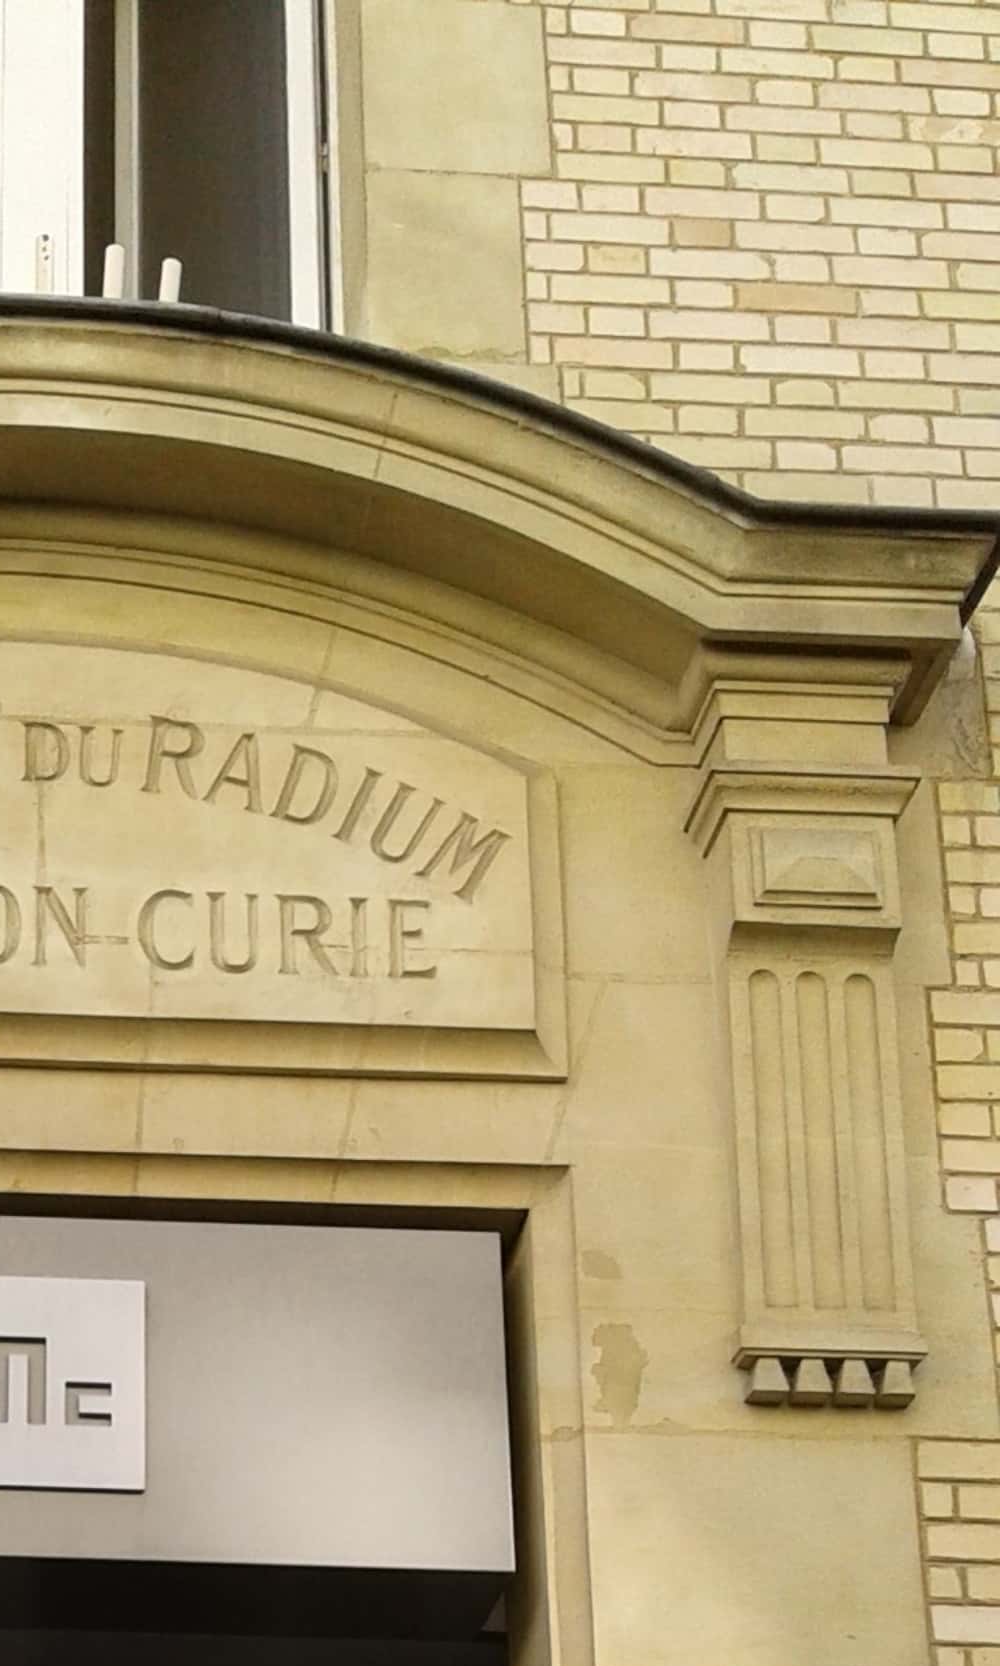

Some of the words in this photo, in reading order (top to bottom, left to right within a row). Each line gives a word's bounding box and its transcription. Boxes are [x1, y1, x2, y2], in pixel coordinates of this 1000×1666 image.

[19, 718, 124, 788] DU
[140, 714, 512, 905] RADIUM
[137, 889, 439, 980] CURIE
